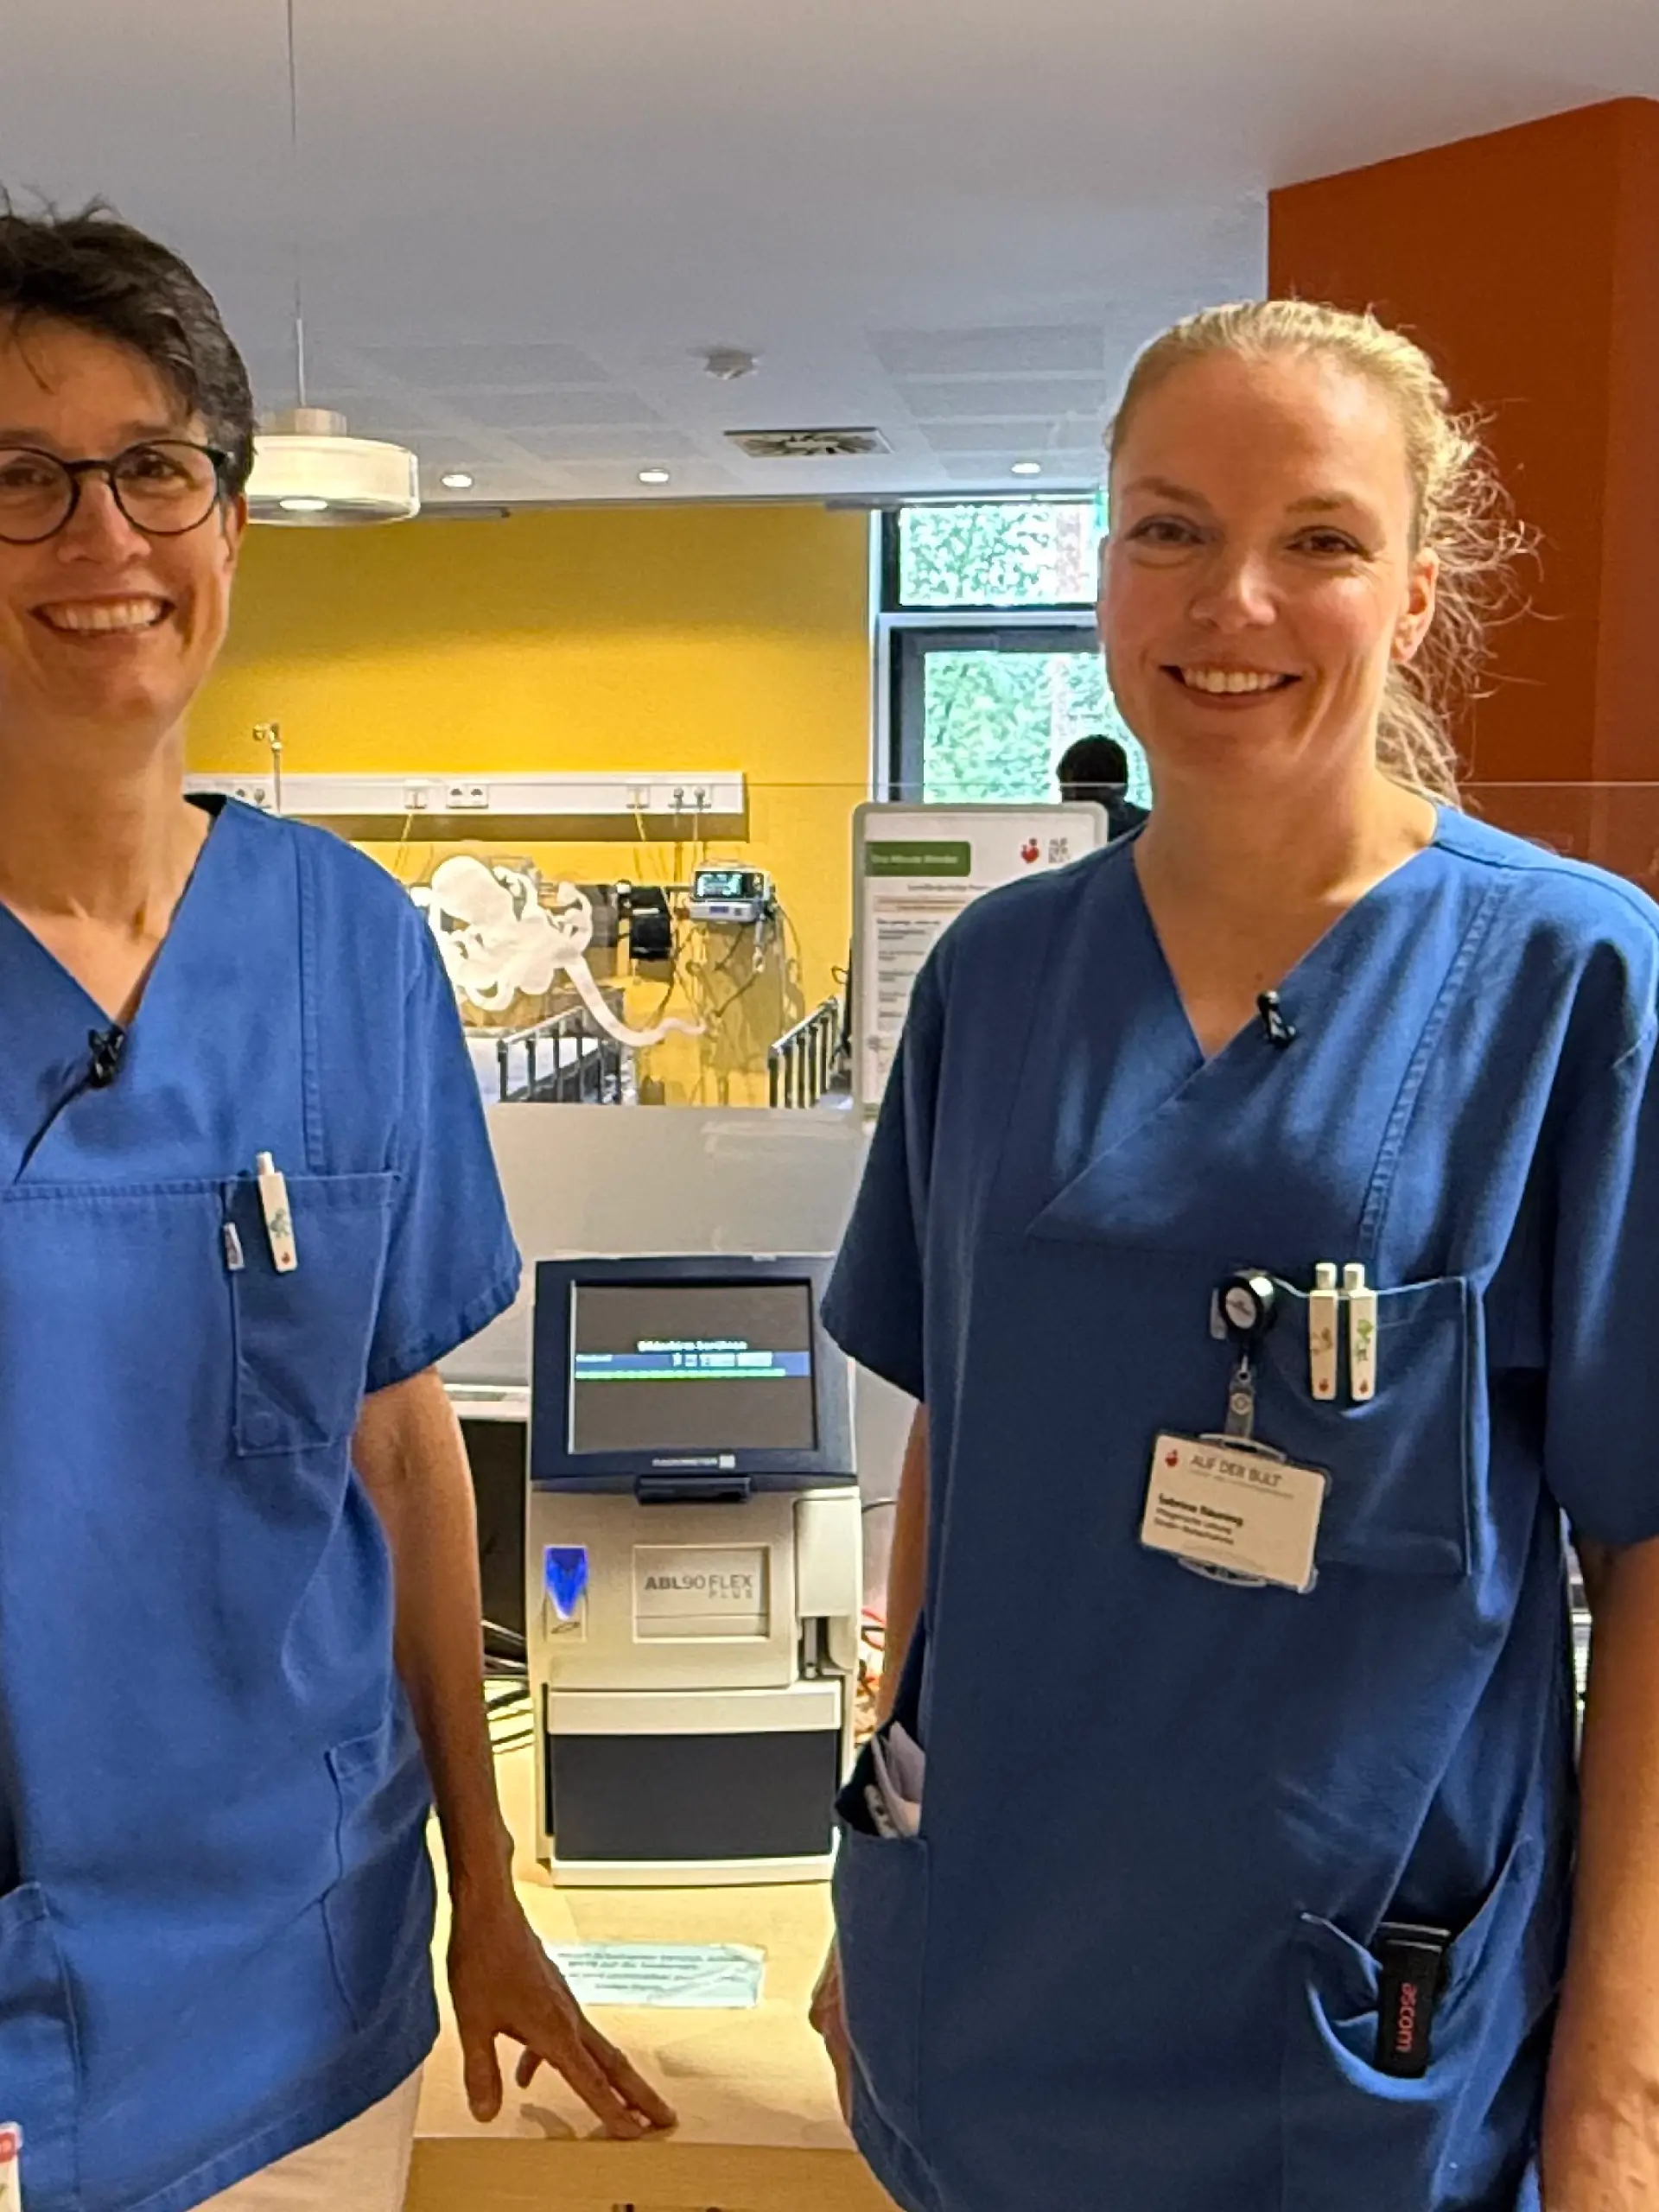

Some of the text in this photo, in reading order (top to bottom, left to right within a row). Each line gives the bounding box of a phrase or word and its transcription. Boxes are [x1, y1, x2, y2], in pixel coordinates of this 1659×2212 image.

[1191, 1455, 1216, 1469] AUF
[1219, 1459, 1245, 1478] DER
[1249, 1467, 1284, 1487] BULT
[645, 1574, 753, 1590] ABL90 FLEX
[1396, 1983, 1417, 2052] ascom
